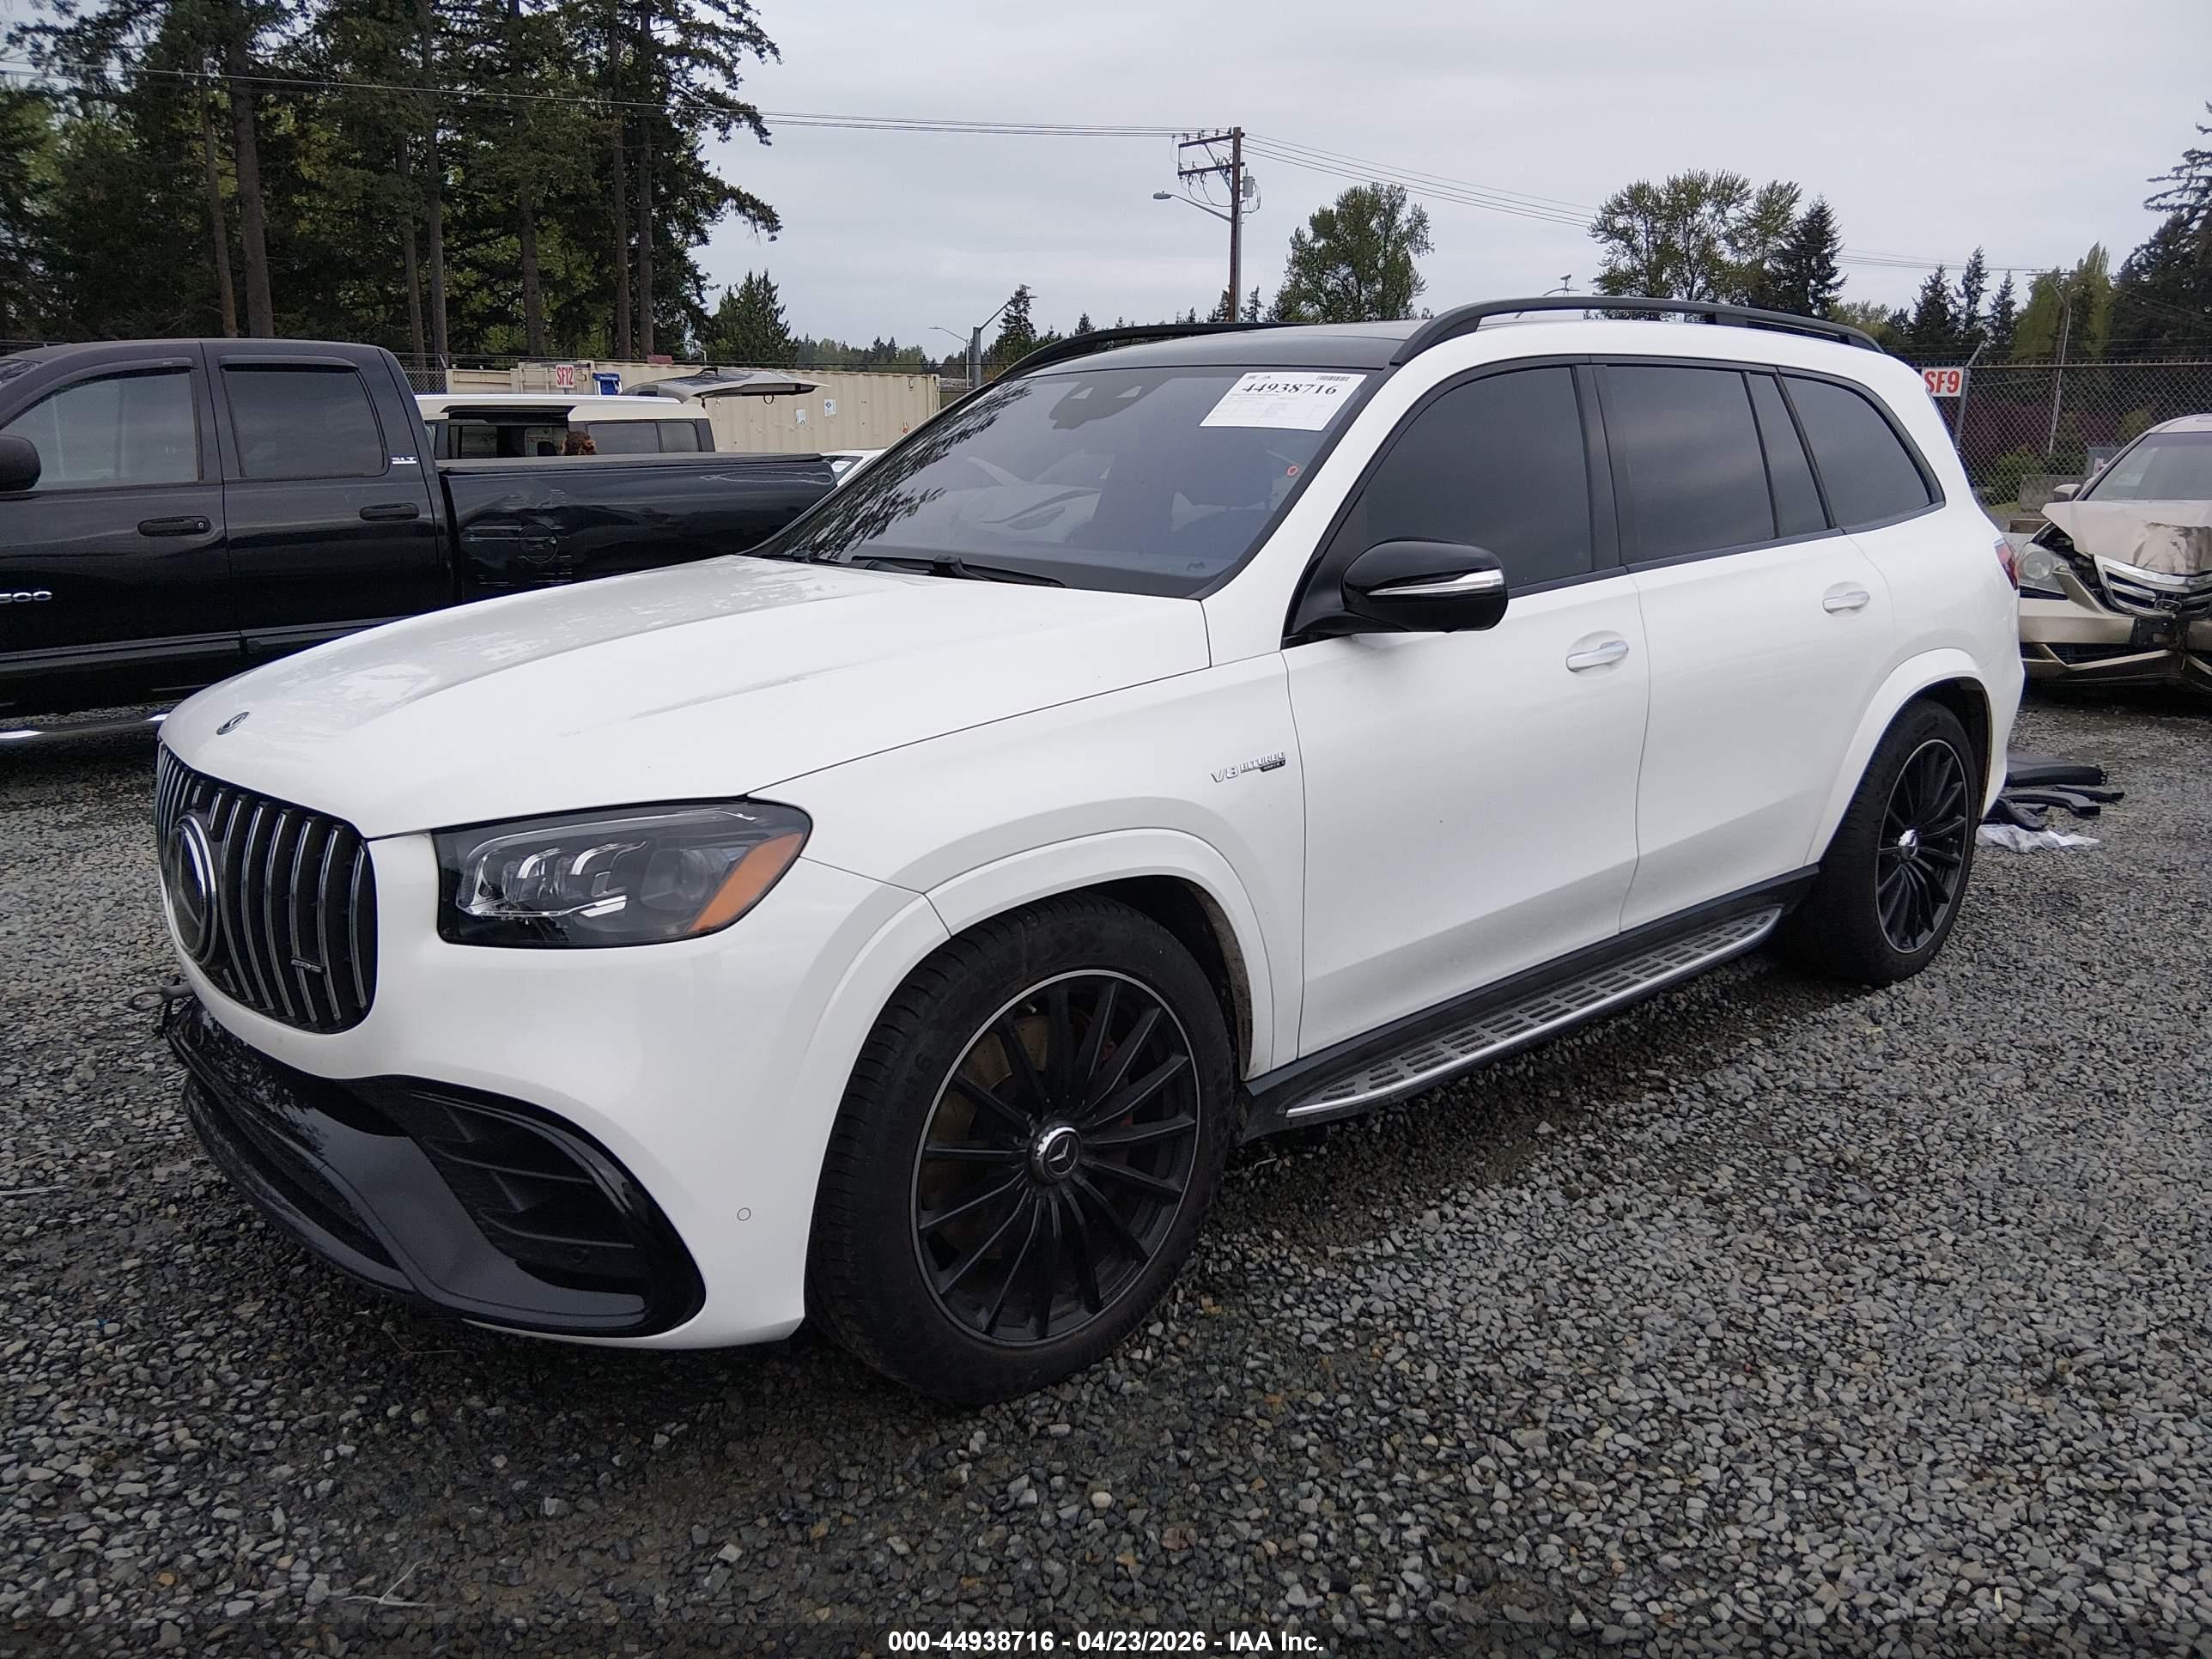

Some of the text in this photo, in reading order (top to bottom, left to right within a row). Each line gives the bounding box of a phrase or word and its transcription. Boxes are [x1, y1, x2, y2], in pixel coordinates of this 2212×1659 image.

[556, 367, 574, 386] SF12
[1923, 370, 1960, 393] SF9
[1242, 383, 1338, 395] 44938716
[1210, 766, 1239, 783] V8
